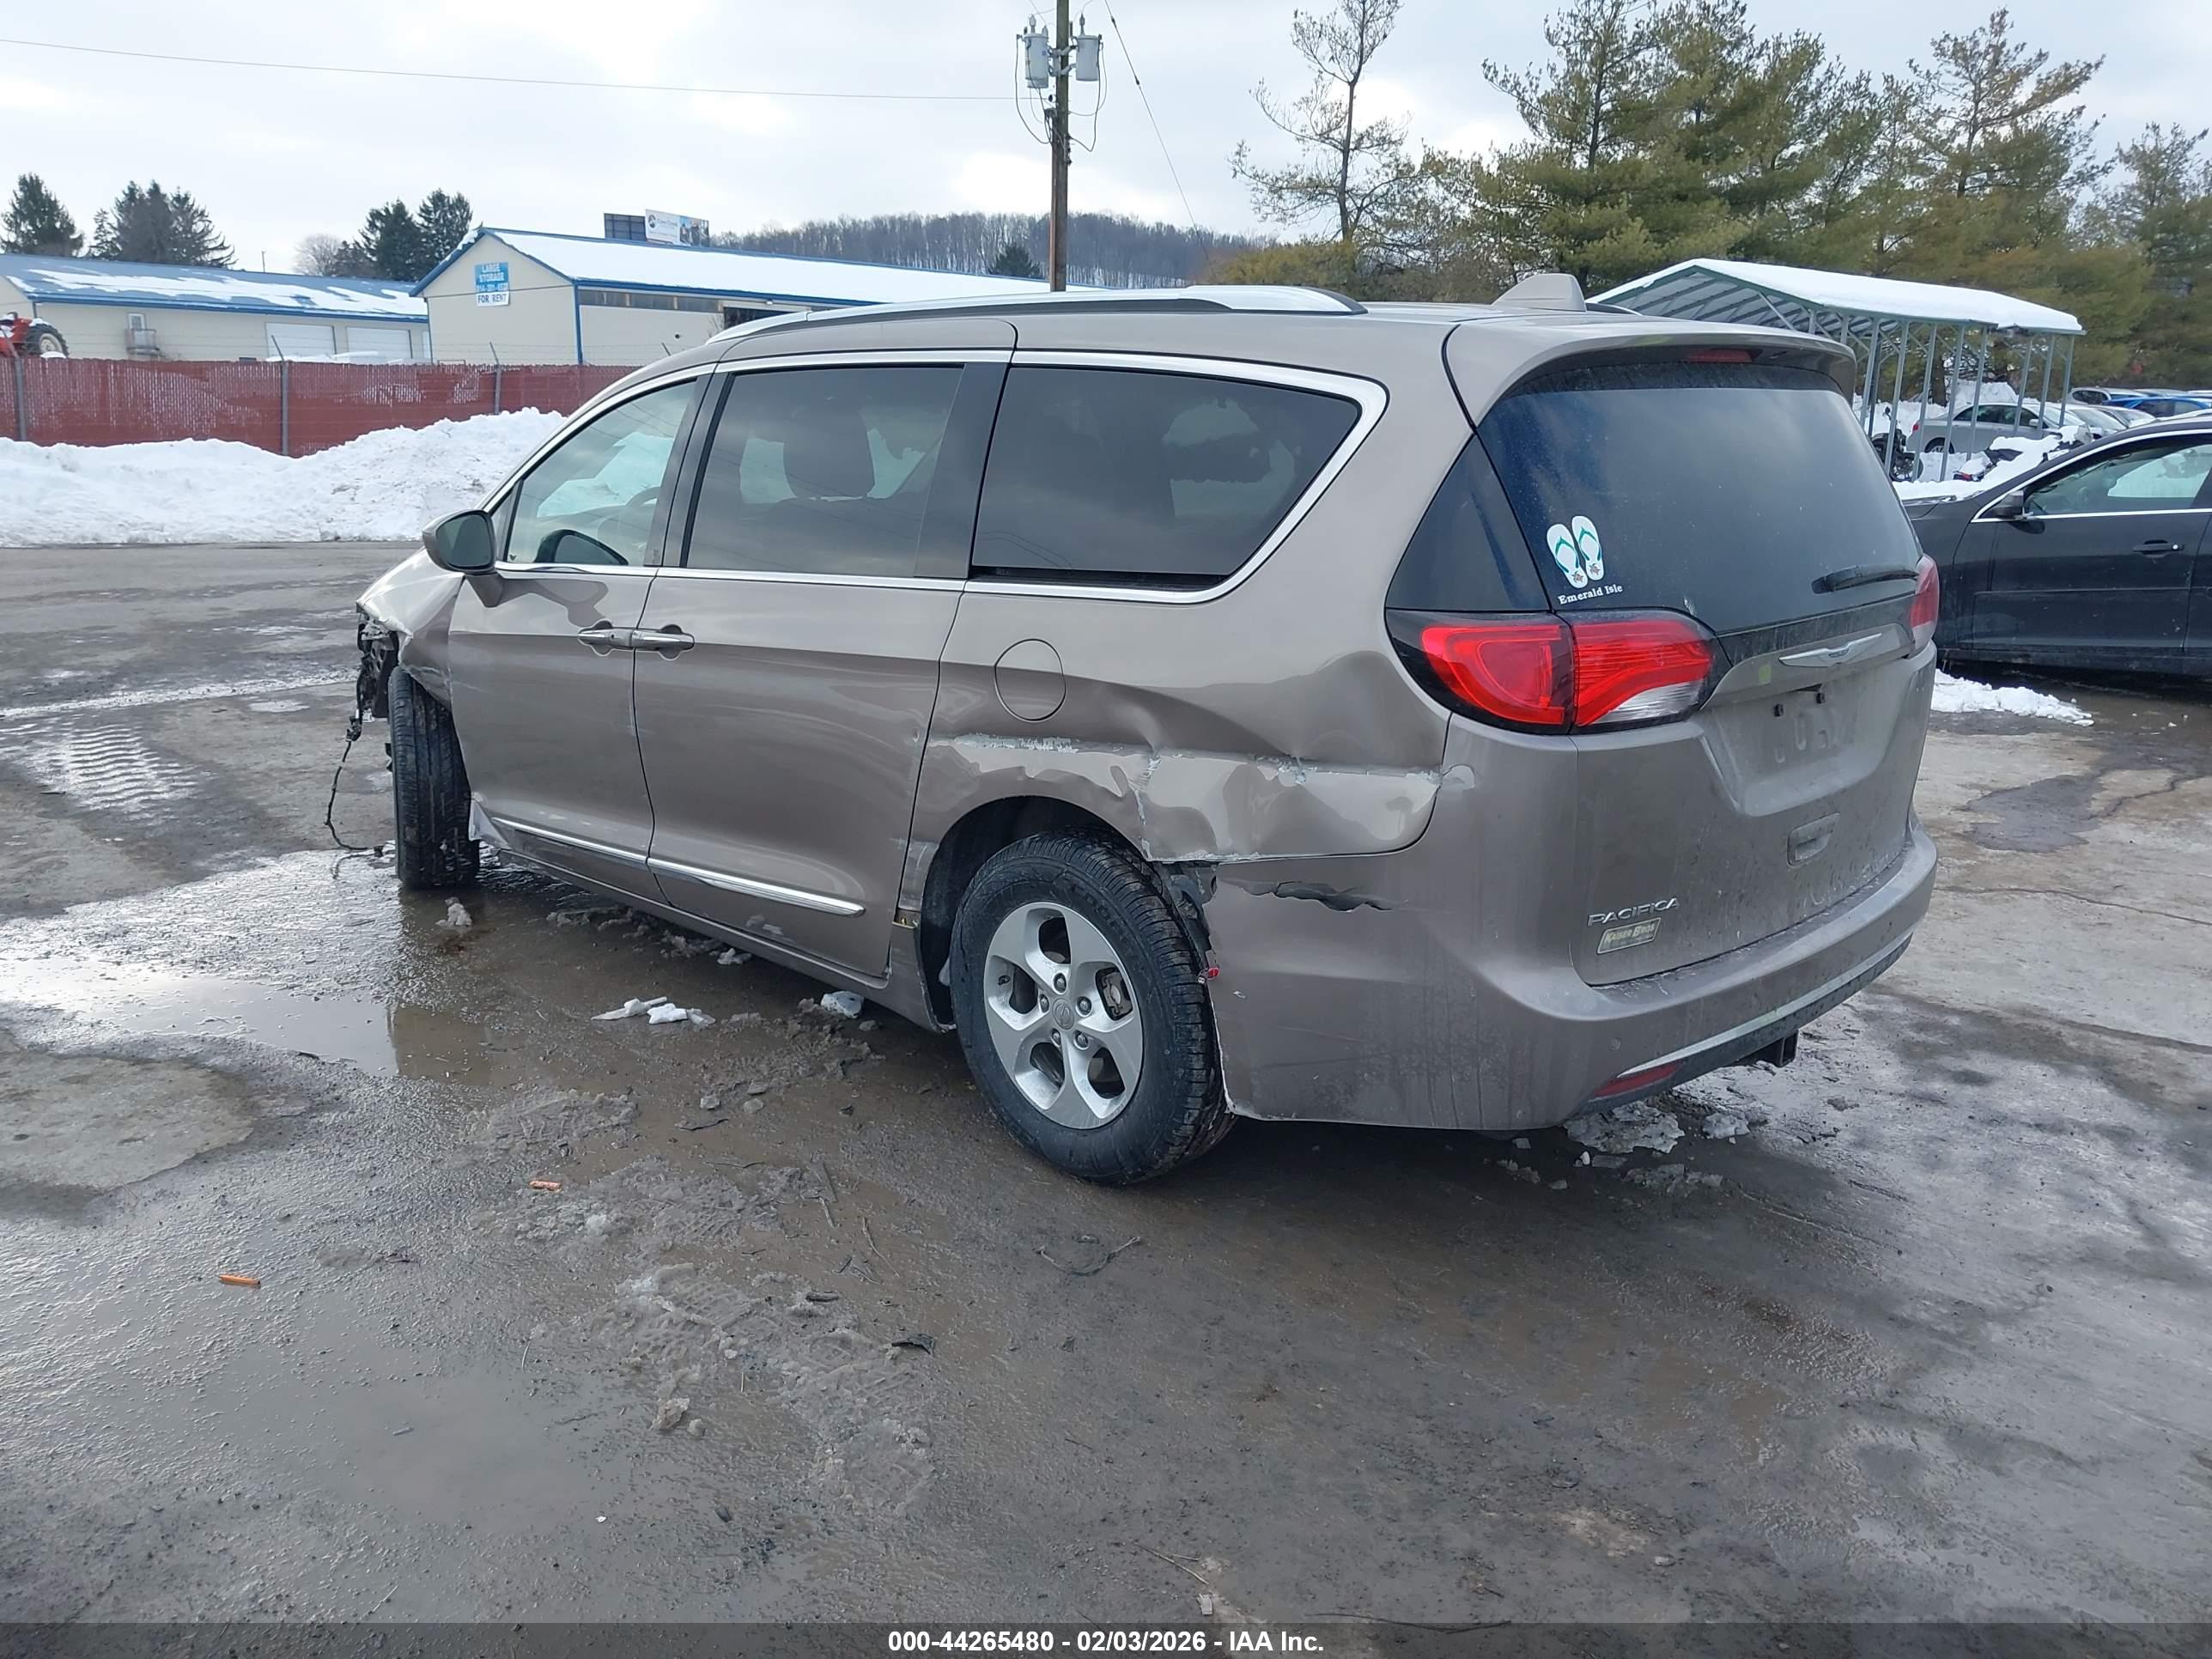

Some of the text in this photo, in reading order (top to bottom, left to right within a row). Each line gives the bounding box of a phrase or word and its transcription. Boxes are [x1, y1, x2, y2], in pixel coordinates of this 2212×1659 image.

[479, 272, 505, 282] STORAGE
[477, 294, 507, 303] FOR RENT
[1558, 584, 1623, 605] Emerald Isle
[1588, 897, 1680, 927] PACIFICA
